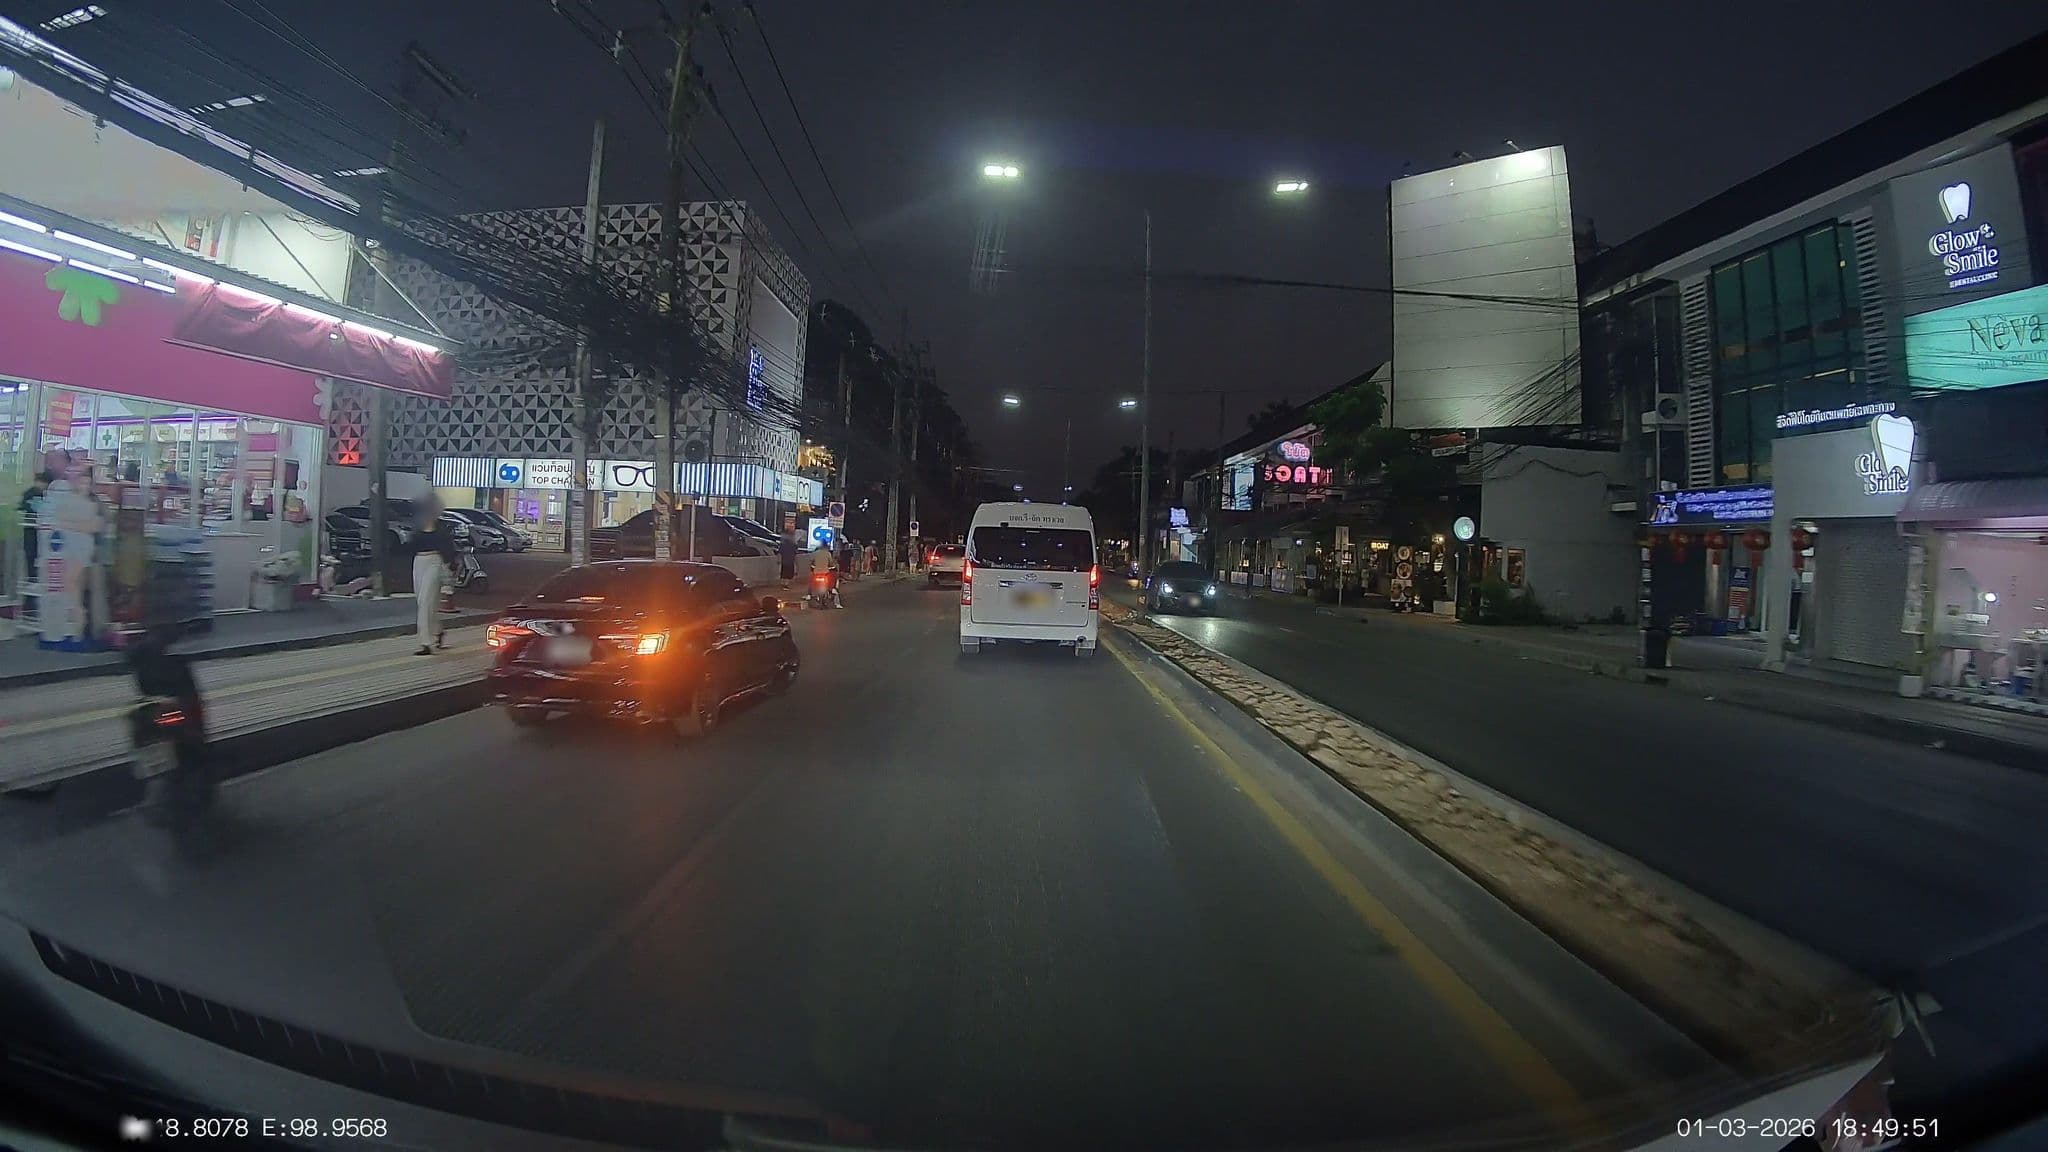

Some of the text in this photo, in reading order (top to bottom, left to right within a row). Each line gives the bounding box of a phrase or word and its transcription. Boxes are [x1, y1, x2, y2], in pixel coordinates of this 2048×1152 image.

[1929, 230, 1981, 256] Glow
[1944, 245, 1999, 276] Smile
[1855, 453, 1883, 477] Glo
[531, 476, 550, 485] TOP
[1864, 472, 1910, 495] Smile
